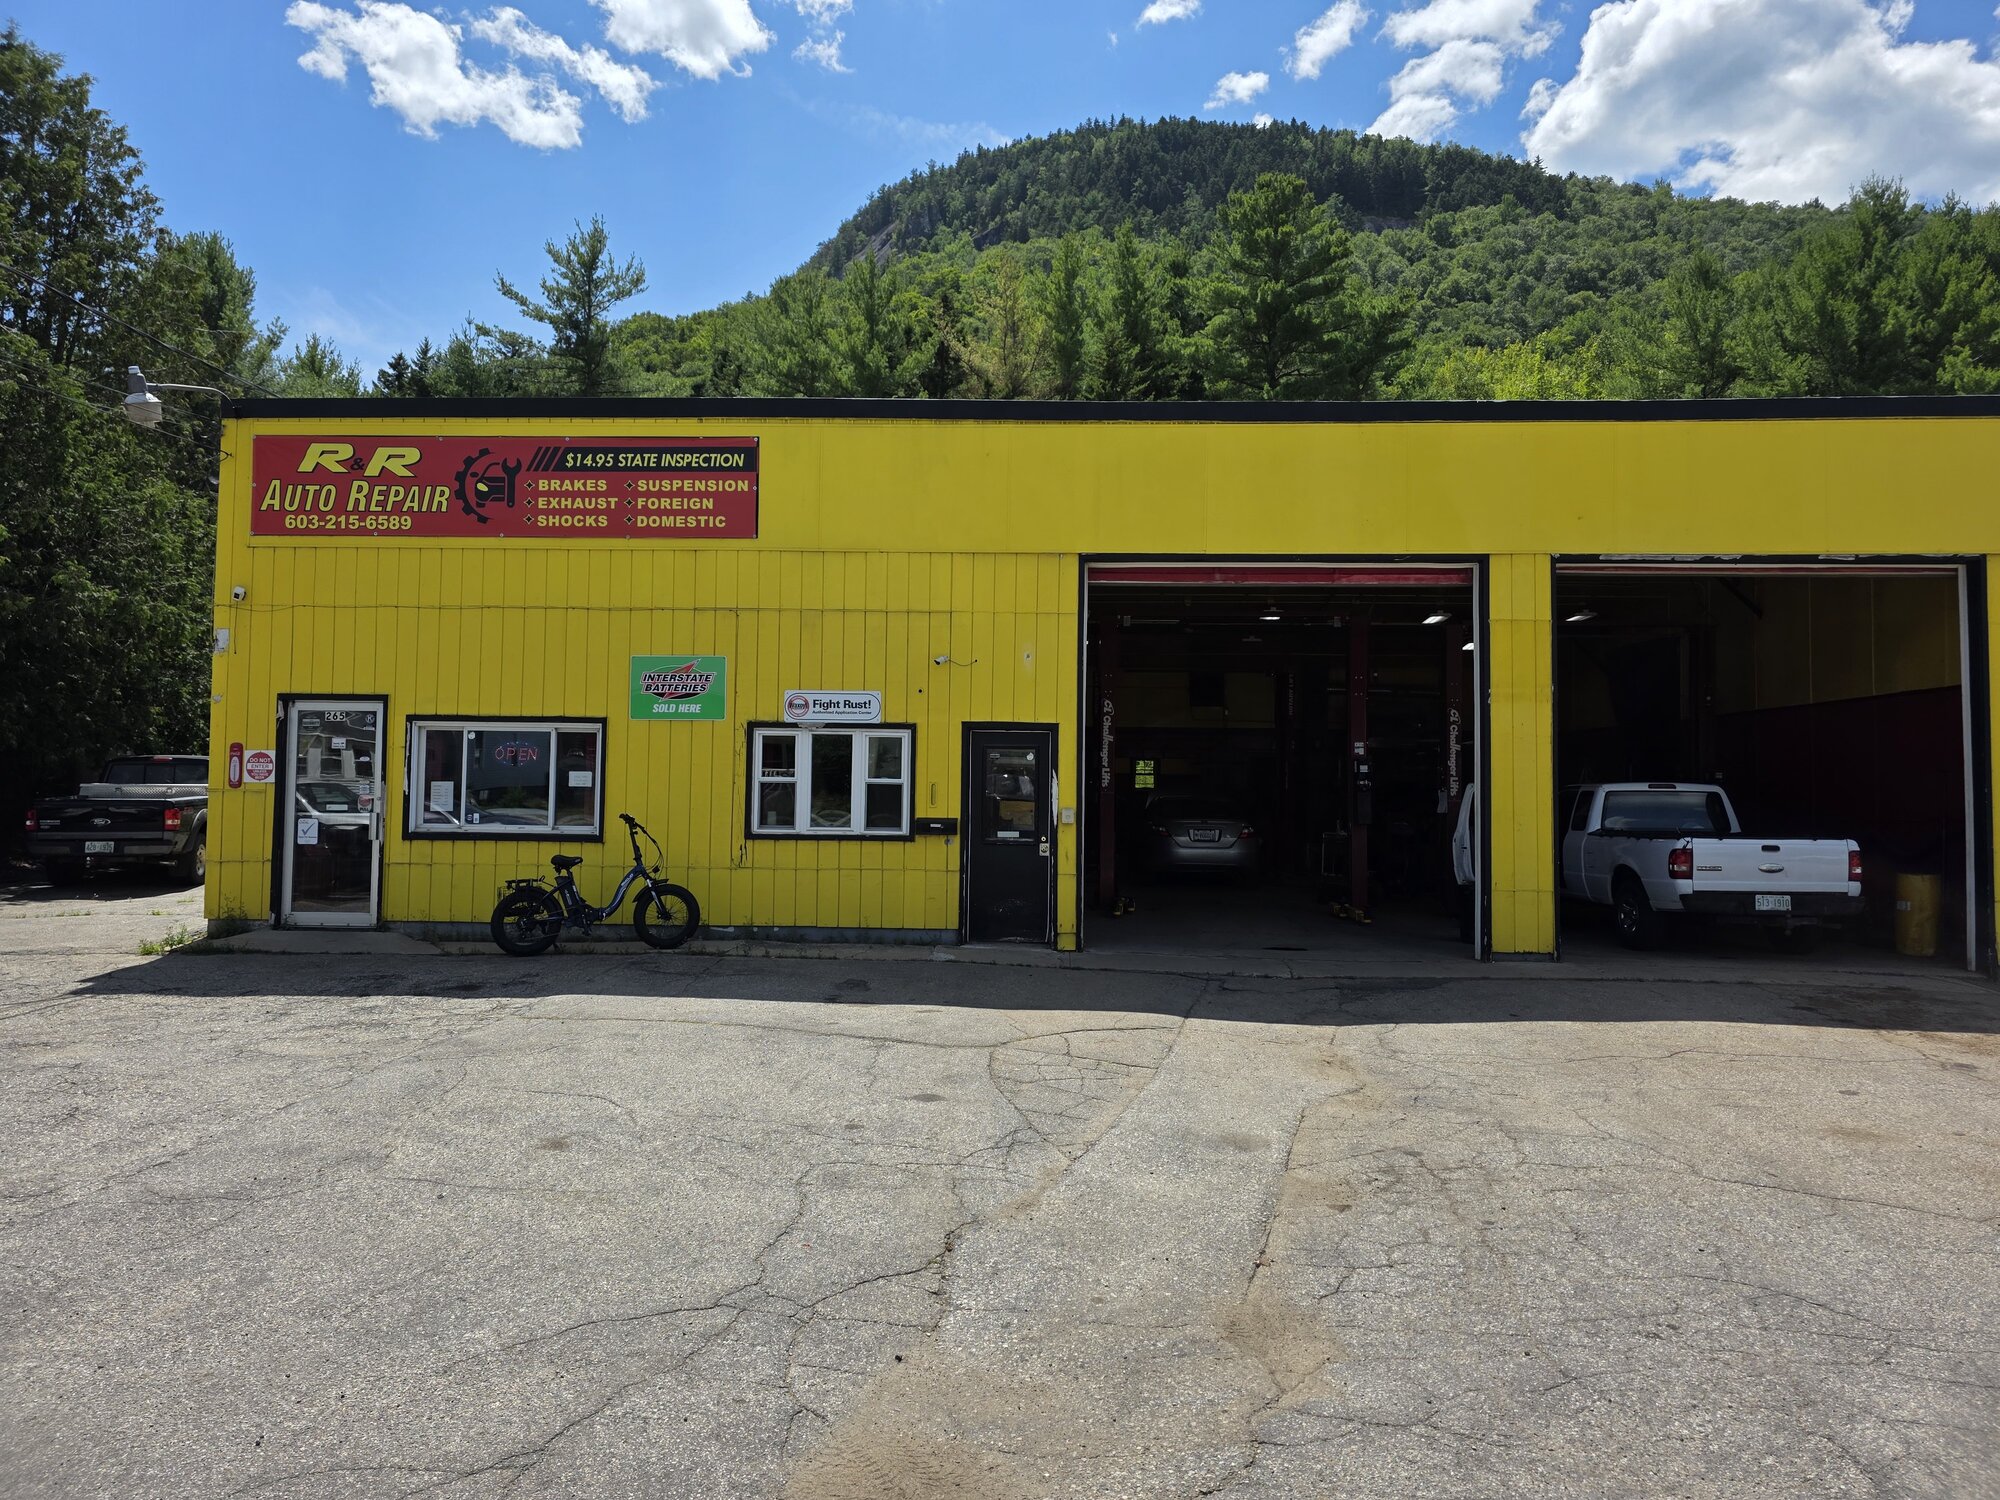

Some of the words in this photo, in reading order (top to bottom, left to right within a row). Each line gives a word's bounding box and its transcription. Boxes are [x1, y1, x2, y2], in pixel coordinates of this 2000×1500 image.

[565, 453, 614, 468] $14.95
[617, 453, 657, 467] STATE
[660, 453, 745, 468] INSPECTION
[538, 479, 607, 491] BRAKES
[637, 479, 749, 492] SUSPENSION
[259, 478, 337, 512] AUTO
[345, 479, 450, 513] REPAIR
[537, 497, 618, 509] EXHAUST
[637, 497, 714, 509] FOREIGN
[284, 514, 412, 530] 603-215-6589
[537, 515, 608, 527] SHOCKS
[637, 515, 726, 528] DOMESTIC
[642, 673, 713, 683] INTERSTATE
[645, 683, 707, 692] BATTERIES
[652, 703, 676, 713] SOLD
[677, 704, 702, 713] HERE
[812, 699, 841, 711] Fight
[843, 699, 871, 709] Rust!
[326, 711, 345, 721] 265
[1100, 715, 1114, 767] Challenger
[495, 746, 538, 761] OPEN
[1448, 725, 1461, 776] Challenger
[1101, 767, 1111, 788] Lifts
[1450, 777, 1460, 795] Lifts
[1757, 898, 1770, 907] 513
[1774, 898, 1790, 908] 1910
